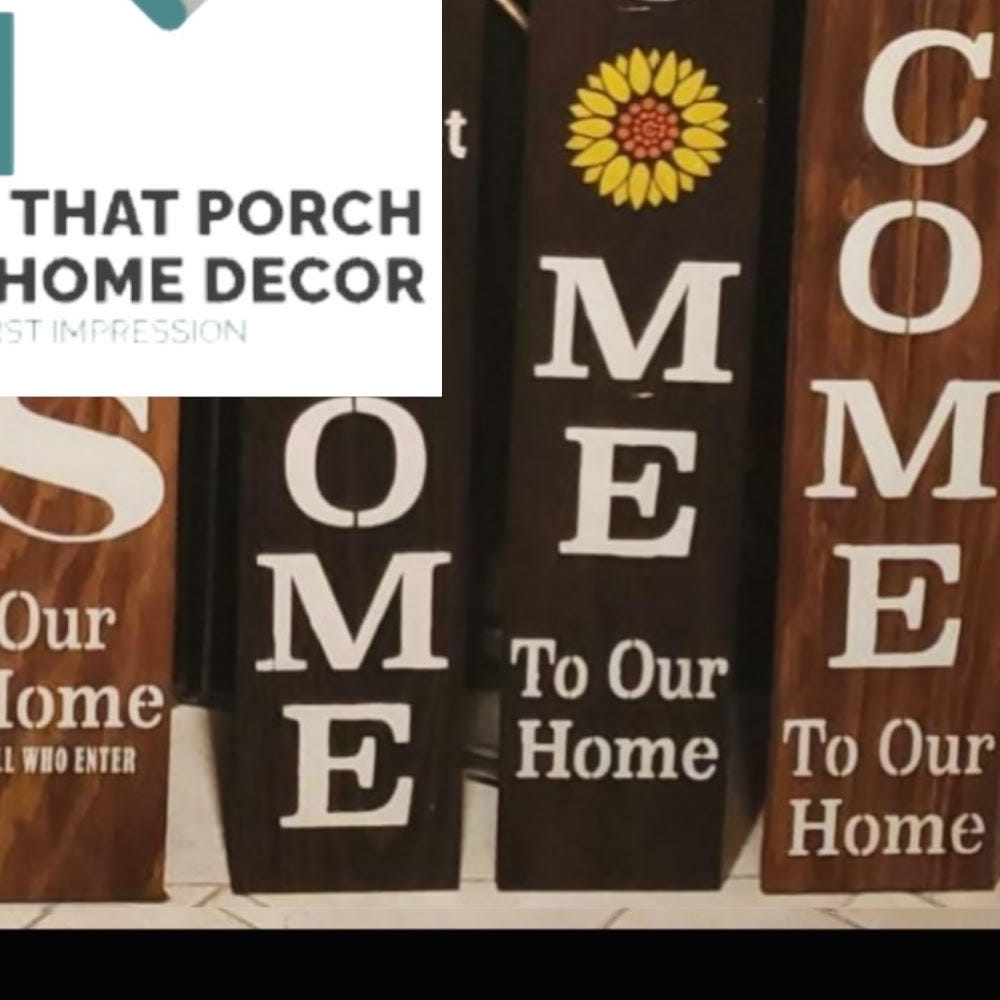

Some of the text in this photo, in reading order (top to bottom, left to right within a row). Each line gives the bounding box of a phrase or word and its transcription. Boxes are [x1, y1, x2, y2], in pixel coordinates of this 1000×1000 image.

[256, 397, 452, 829] OME
[510, 637, 729, 700] To Our
[21, 746, 68, 774] WHO
[74, 746, 137, 774] ENTER
[515, 718, 720, 781] Home
[783, 717, 996, 777] To Our
[787, 797, 986, 857] Home
